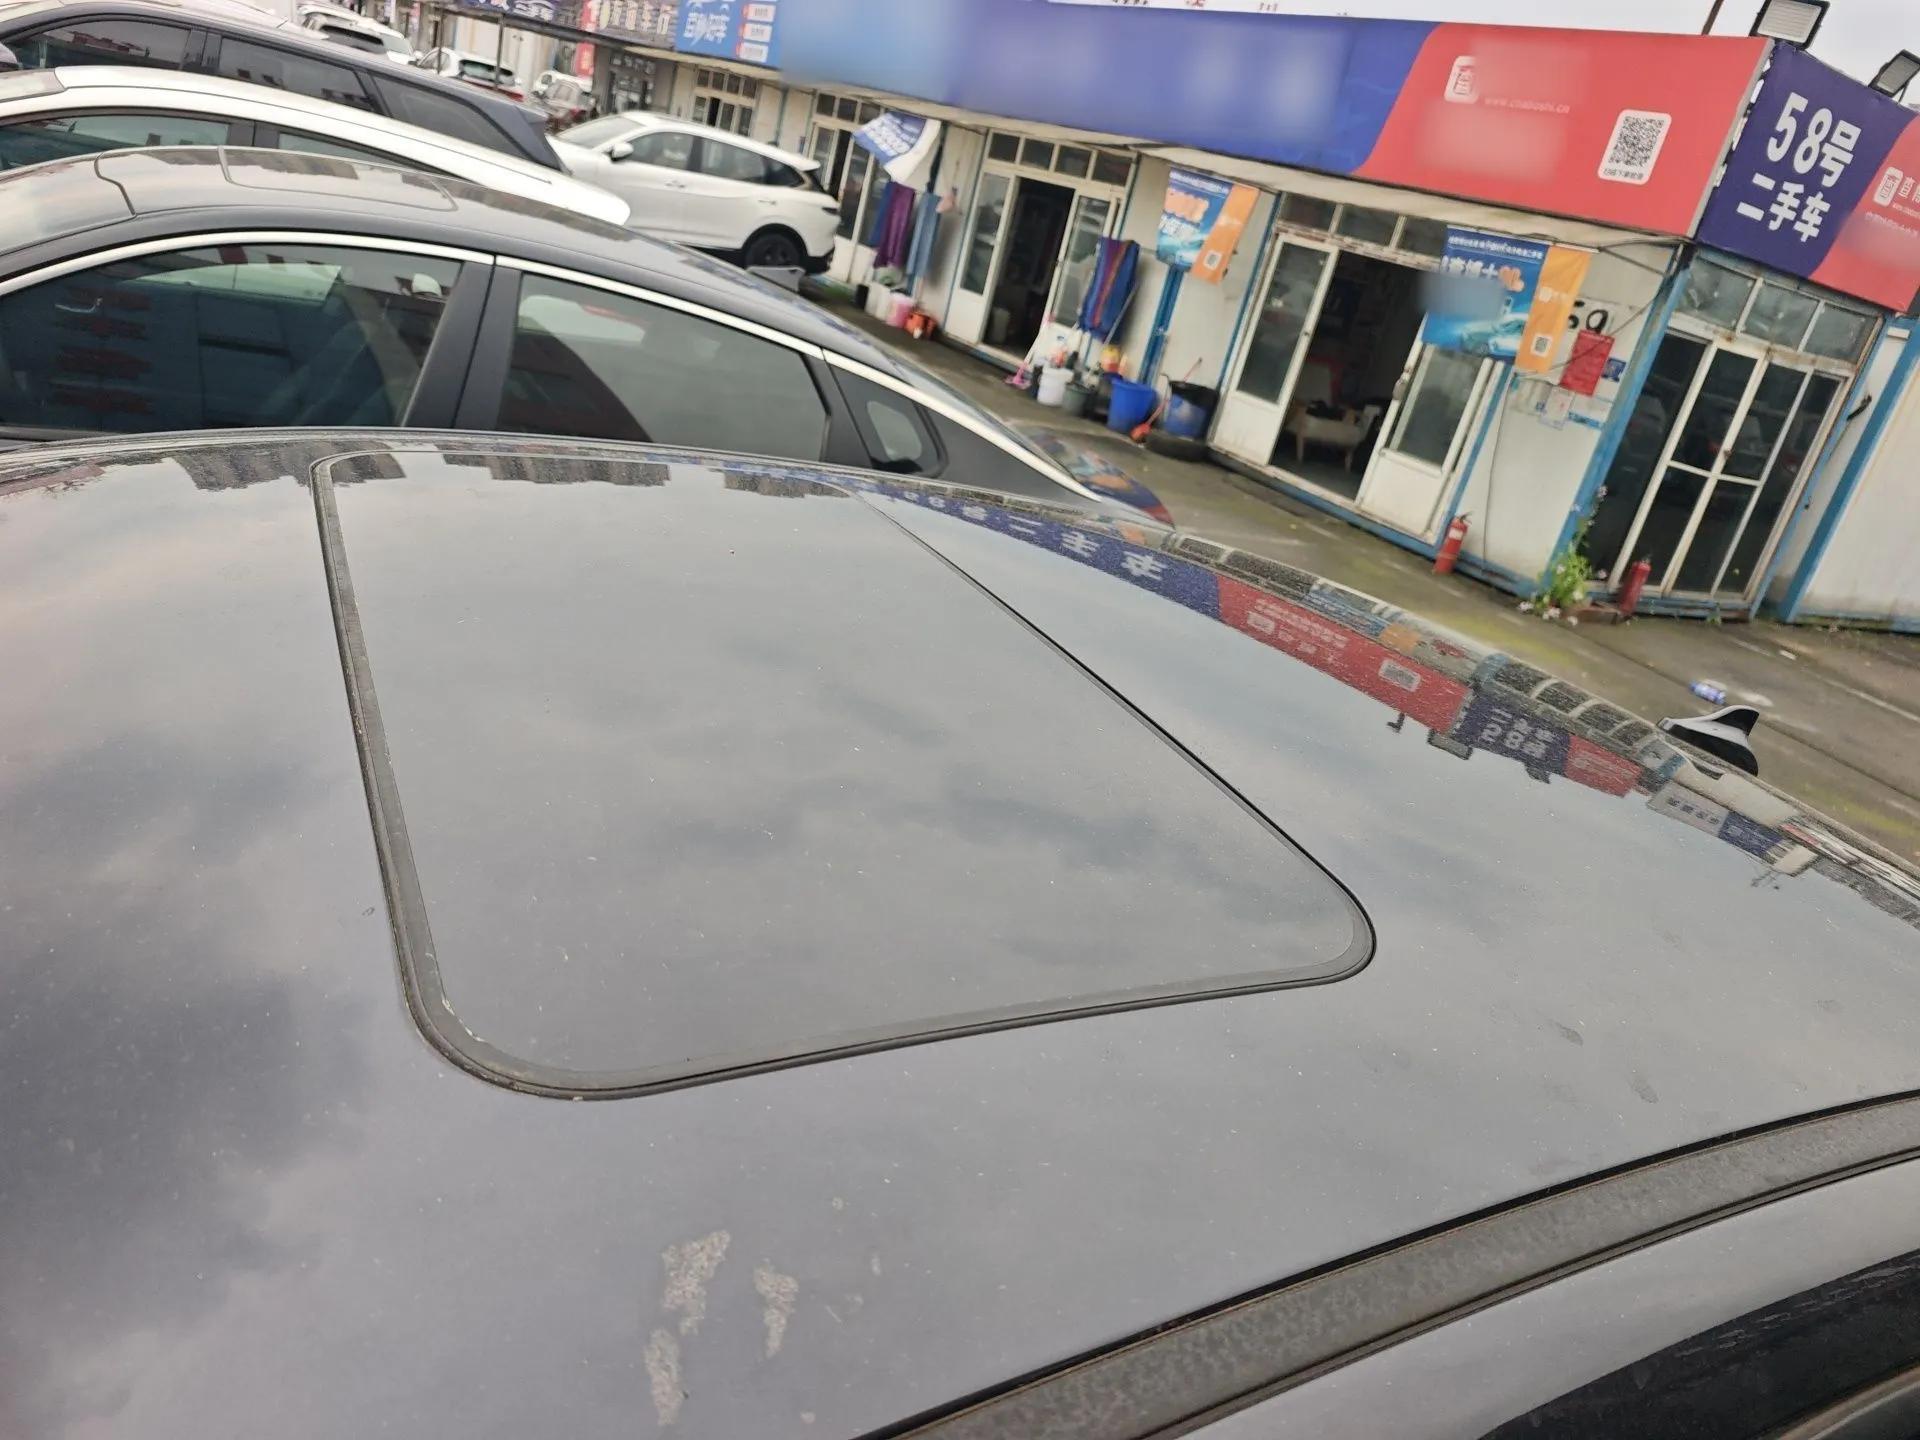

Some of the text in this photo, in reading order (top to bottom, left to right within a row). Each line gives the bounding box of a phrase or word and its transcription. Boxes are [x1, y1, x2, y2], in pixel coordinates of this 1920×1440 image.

[1766, 91, 1862, 188] 58号
[1735, 172, 1831, 243] 二手车
